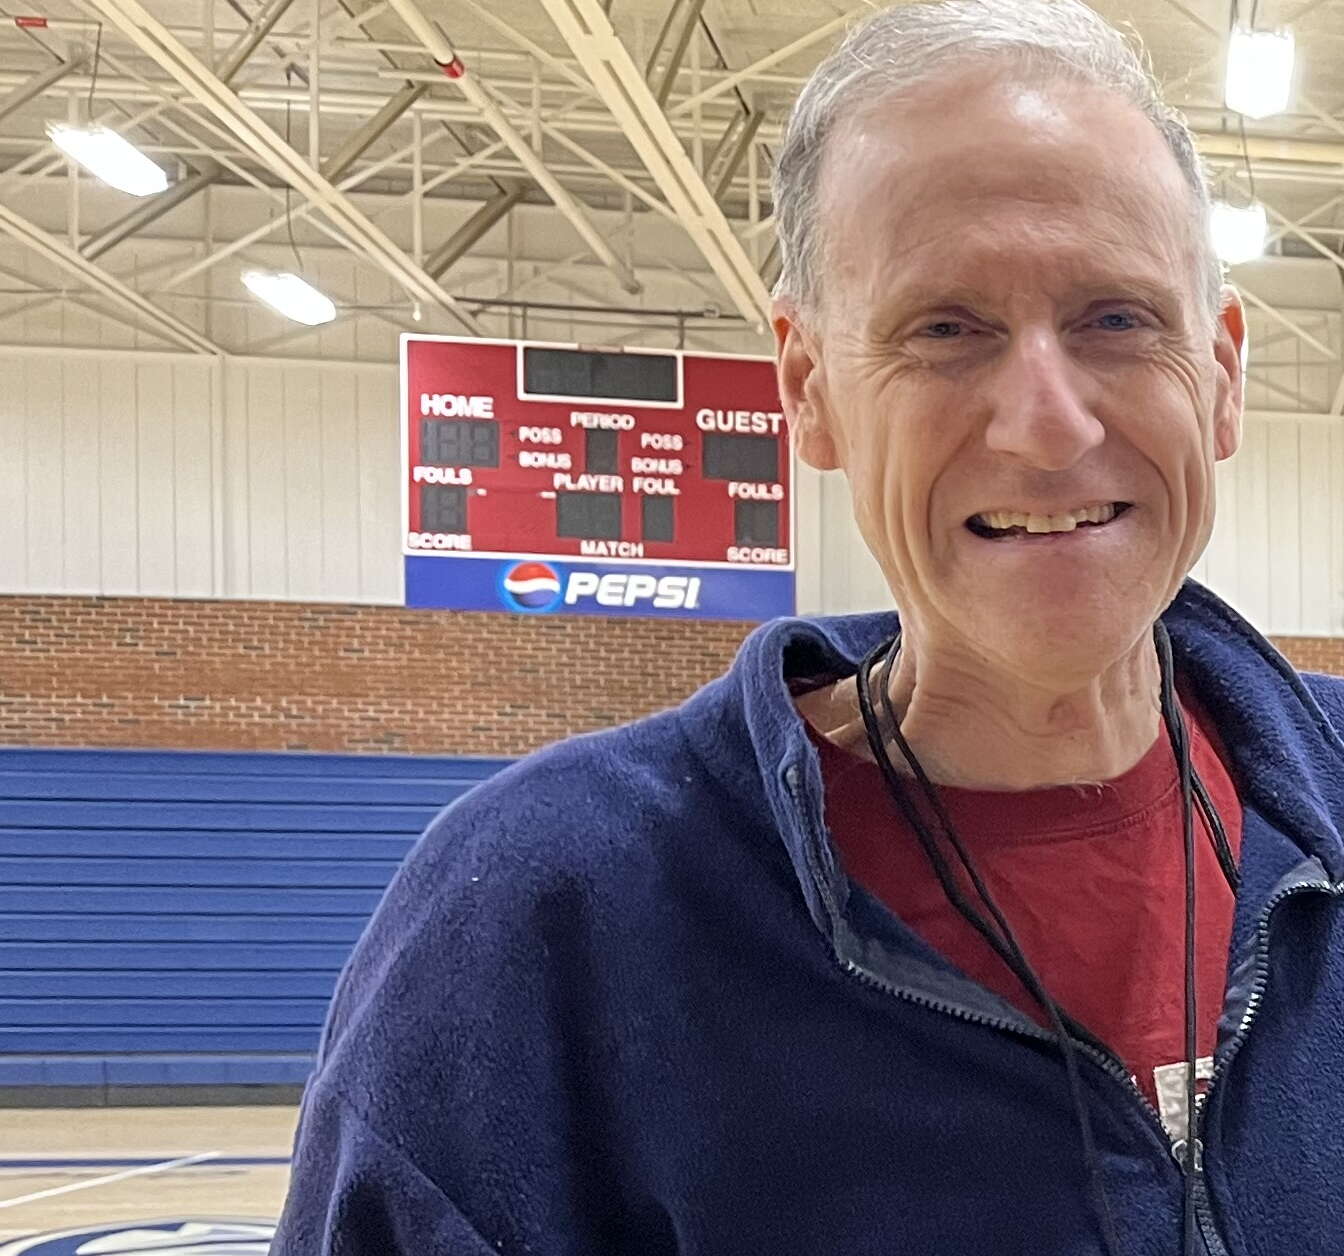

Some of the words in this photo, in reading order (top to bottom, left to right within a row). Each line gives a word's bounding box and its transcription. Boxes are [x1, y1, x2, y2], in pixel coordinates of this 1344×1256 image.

[420, 394, 494, 418] HOME
[570, 412, 635, 430] PERIOD
[696, 408, 783, 434] GUEST
[518, 426, 562, 445] POSS
[640, 432, 684, 451] POSS
[518, 451, 572, 470] BONUS
[631, 456, 684, 475] BONUS
[413, 466, 473, 485] FOULS
[553, 473, 625, 493] PLAYER
[632, 476, 681, 496] FOUL
[727, 481, 784, 500] FOULS
[407, 532, 472, 551] SCORE
[580, 540, 645, 558] MATCH
[726, 547, 789, 565] SCORE
[564, 572, 701, 610] PEPSI
